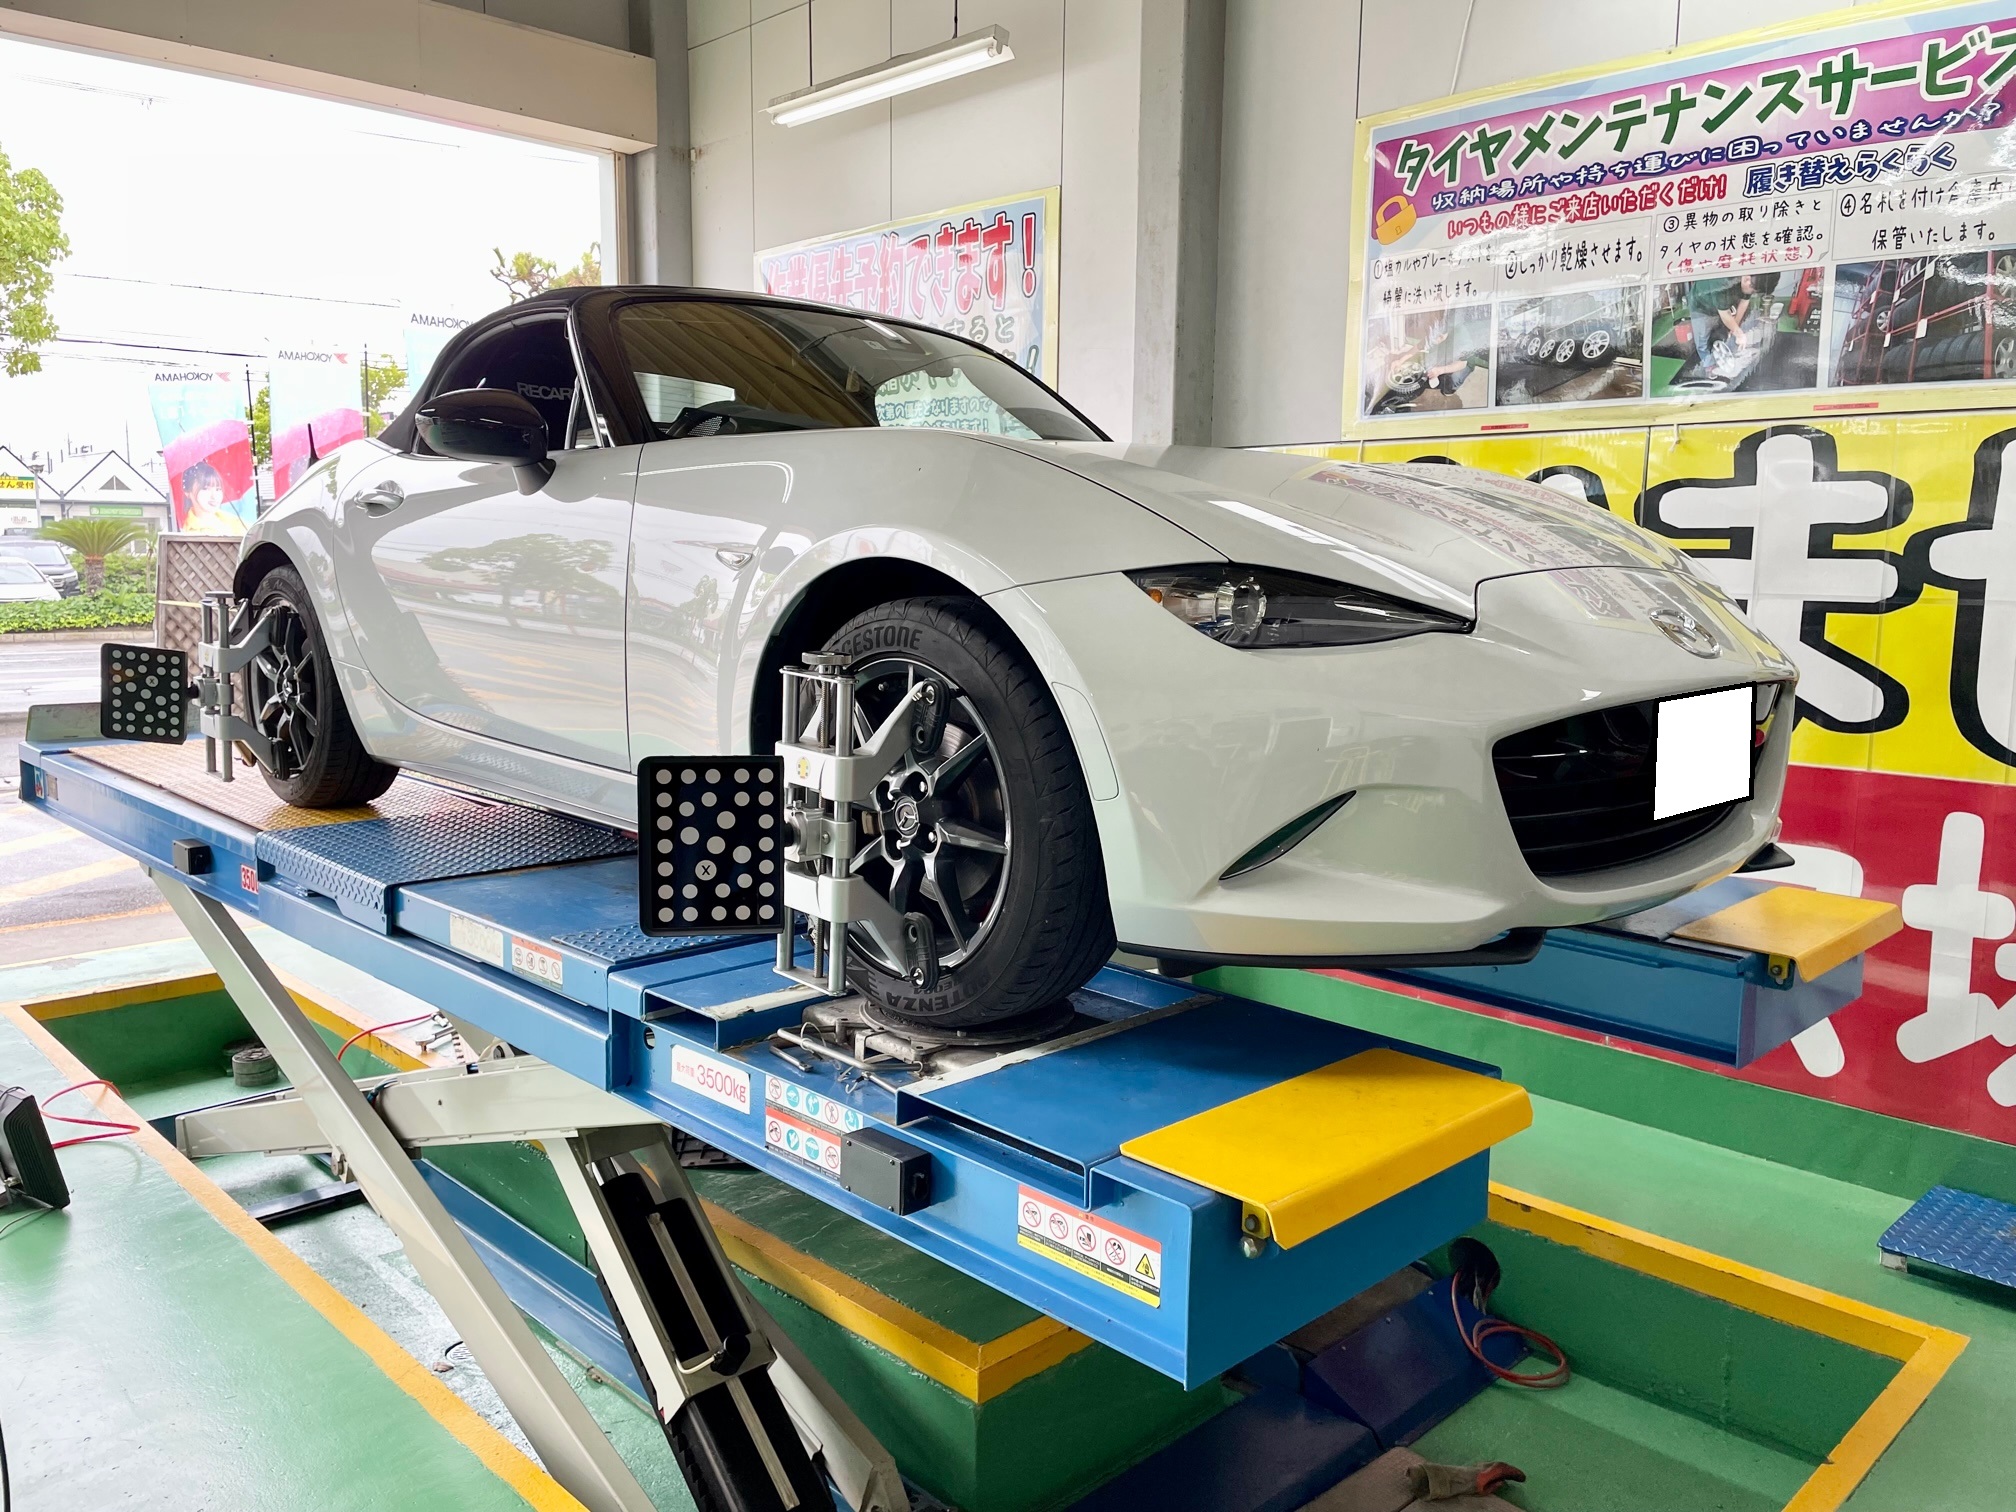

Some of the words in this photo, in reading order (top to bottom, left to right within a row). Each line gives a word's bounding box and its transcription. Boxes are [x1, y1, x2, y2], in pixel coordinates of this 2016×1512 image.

[1744, 142, 1957, 198] 履き替えらくらく
[1660, 225, 1823, 259] タイヤの状態を確認。
[1872, 220, 1995, 250] 保管いたします。
[516, 382, 573, 400] RECAR
[836, 626, 923, 656] GESTONE
[697, 1065, 746, 1103] 3500kg
